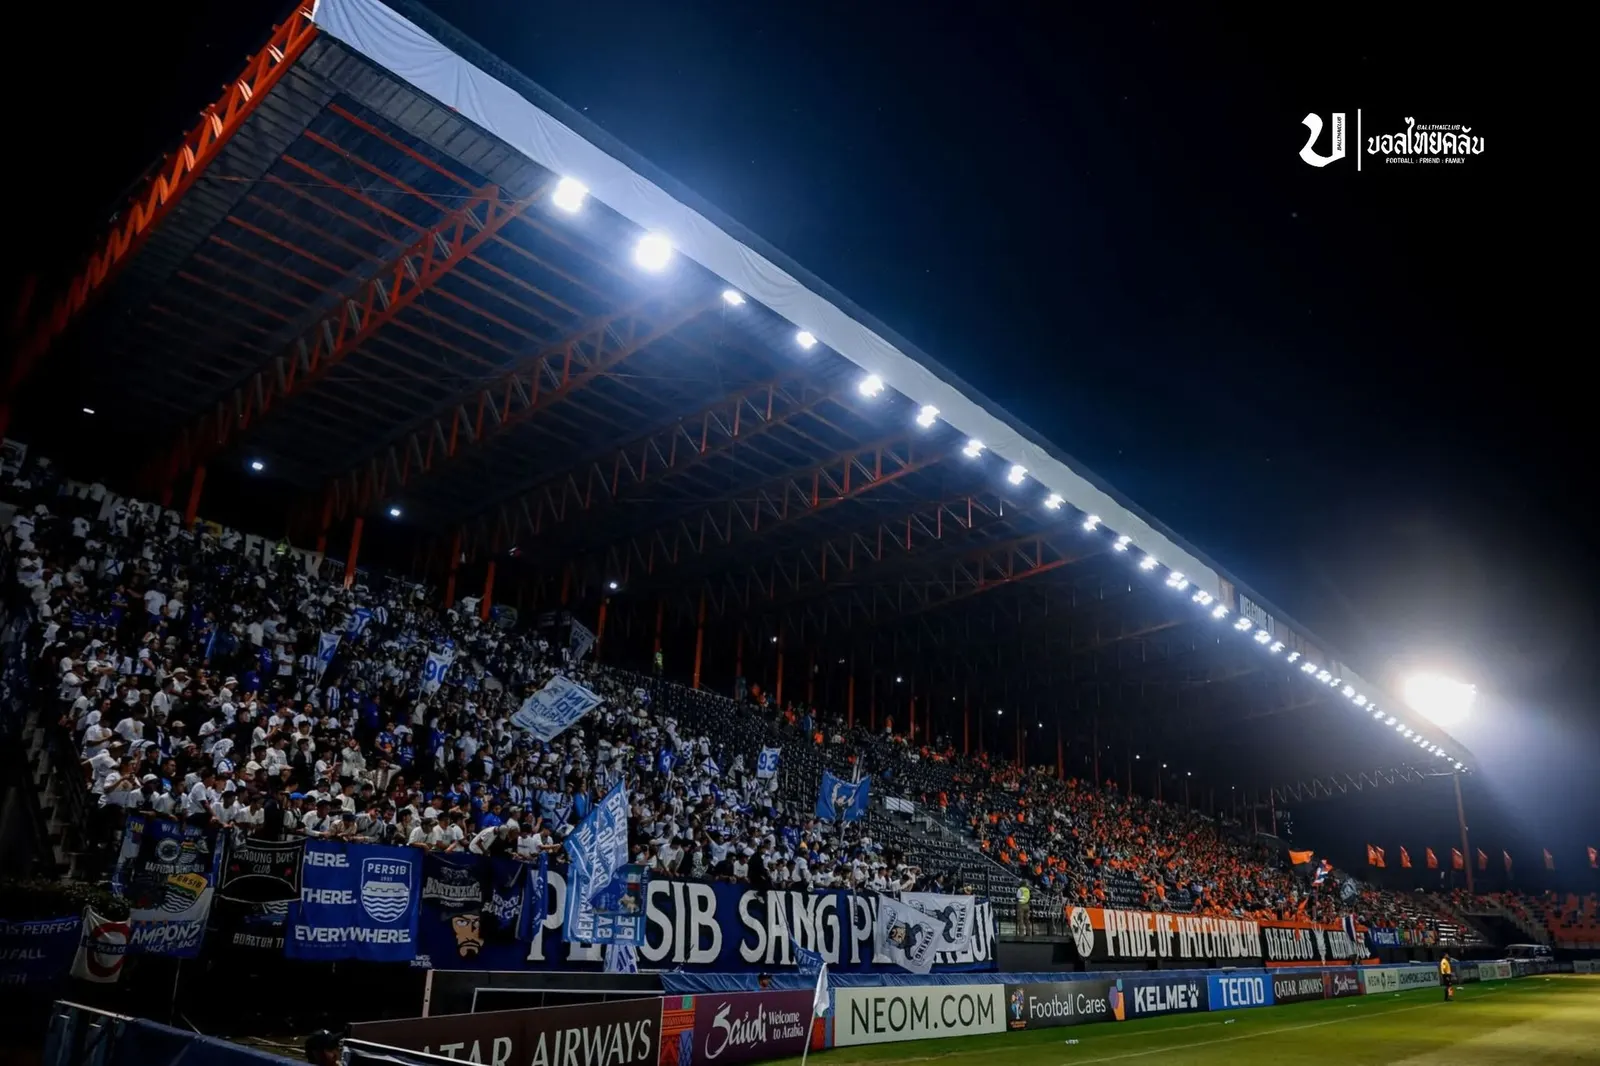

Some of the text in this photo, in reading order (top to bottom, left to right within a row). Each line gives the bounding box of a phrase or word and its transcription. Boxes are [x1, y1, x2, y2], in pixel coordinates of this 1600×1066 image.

[758, 752, 779, 772] 93
[172, 873, 203, 889] PERSIB
[252, 863, 271, 875] CLUB
[367, 862, 407, 875] PERSIB
[302, 887, 357, 905] THERE.
[22, 920, 77, 937] PERFECT
[526, 869, 722, 965] PSIB
[739, 888, 842, 965] SANG
[956, 903, 967, 939] VIKING
[130, 920, 201, 946] AMPIONS
[294, 925, 412, 944] EVERYWHERE.
[915, 930, 935, 960] VIKING
[1103, 908, 1263, 958] PRIDE OF RATCHABURI
[1134, 984, 1187, 1013] KELME
[1218, 977, 1264, 1007] TECNO
[1274, 978, 1323, 999] QATAR AIRWAYS
[851, 993, 995, 1036] NEOM.COM
[1029, 993, 1106, 1019] Football Cares
[532, 1019, 652, 1066] AIRWAYS
[704, 1001, 801, 1060] Saudi Welcome
[773, 1023, 804, 1041] to Arabia
